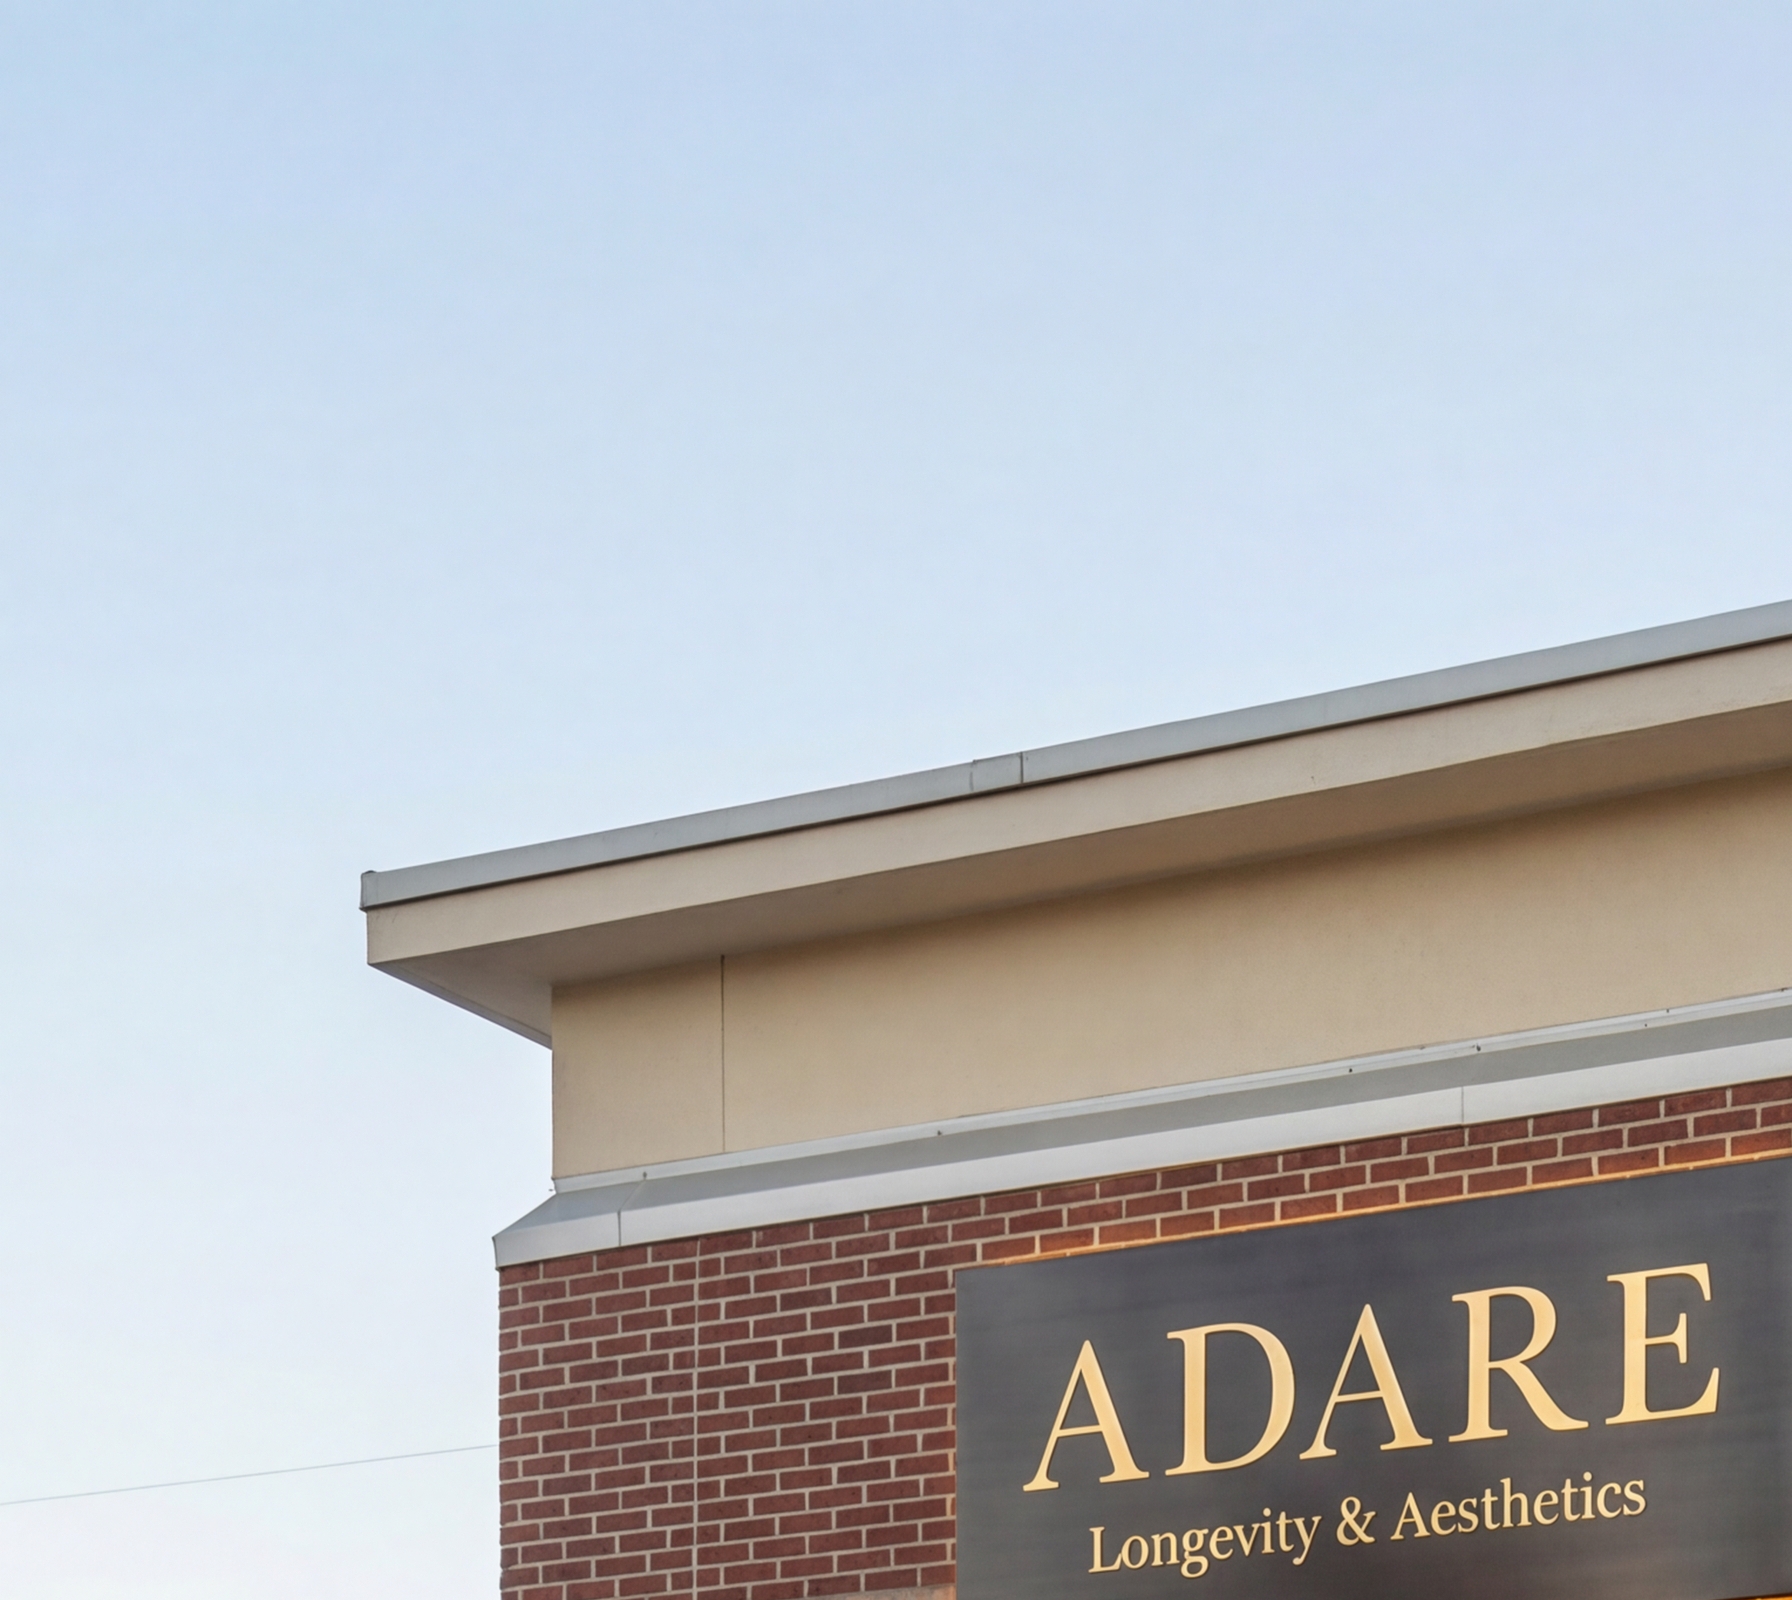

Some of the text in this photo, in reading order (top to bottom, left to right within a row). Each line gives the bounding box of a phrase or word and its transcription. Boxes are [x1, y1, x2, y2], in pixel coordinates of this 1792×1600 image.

[1023, 1262, 1720, 1492] ADARE
[1088, 1472, 1646, 1578] Longevity & Aesthetics
